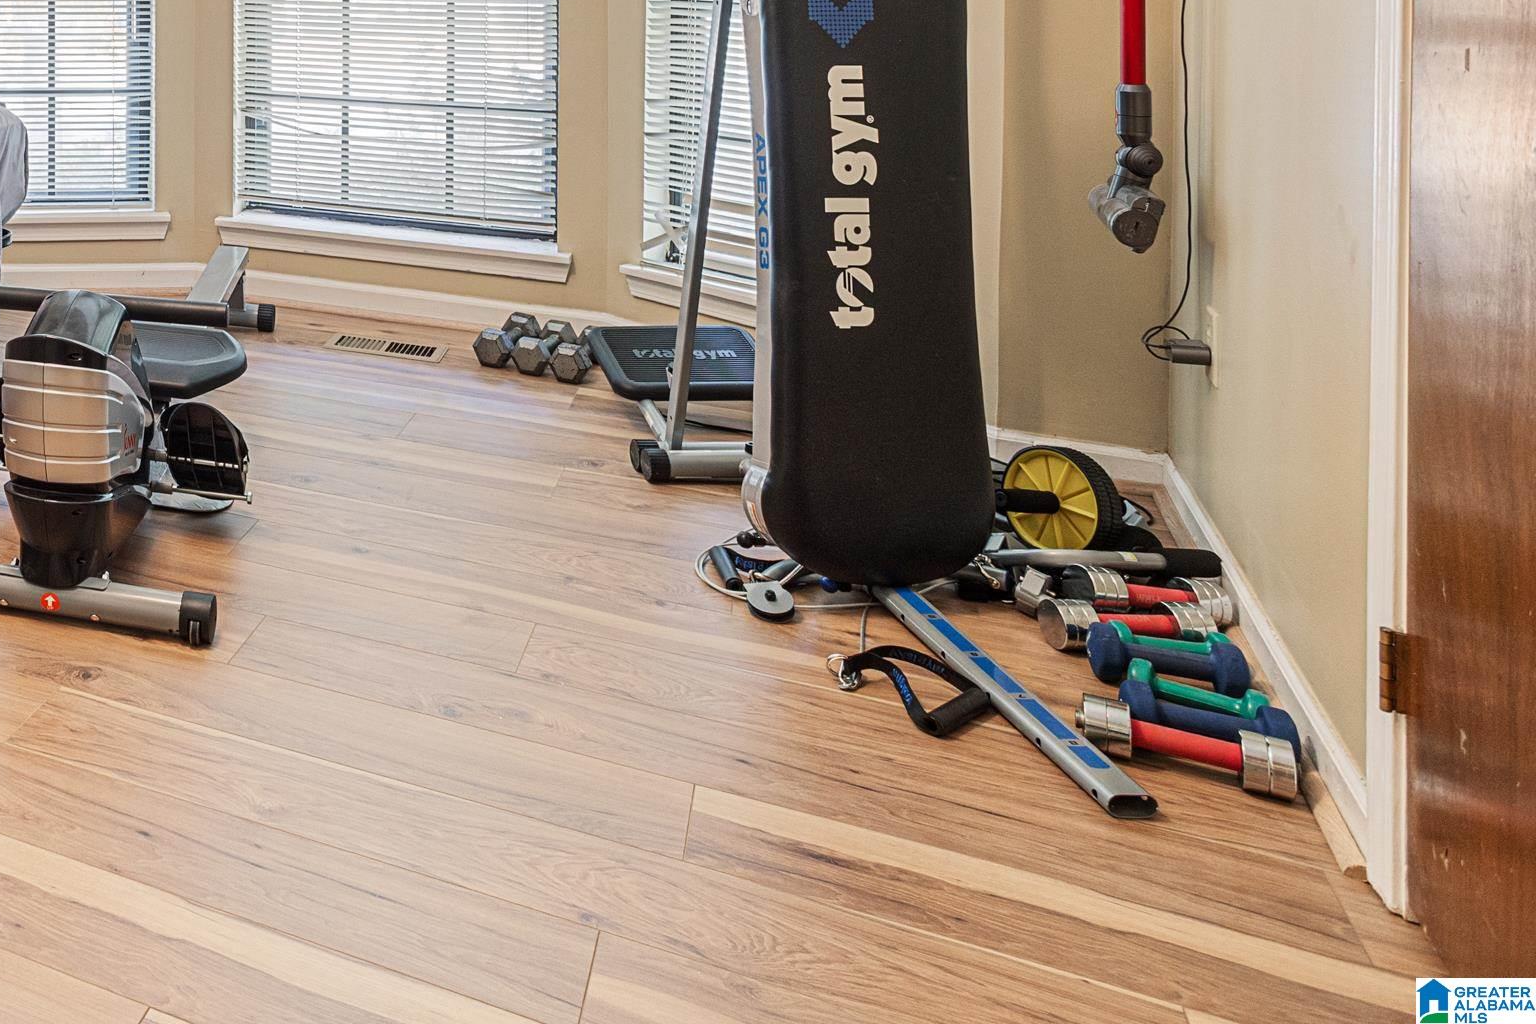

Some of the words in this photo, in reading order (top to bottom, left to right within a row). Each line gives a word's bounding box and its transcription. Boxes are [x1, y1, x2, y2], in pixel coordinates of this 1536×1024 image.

[754, 131, 769, 217] APEX
[827, 64, 880, 186] gym
[824, 197, 875, 330] total
